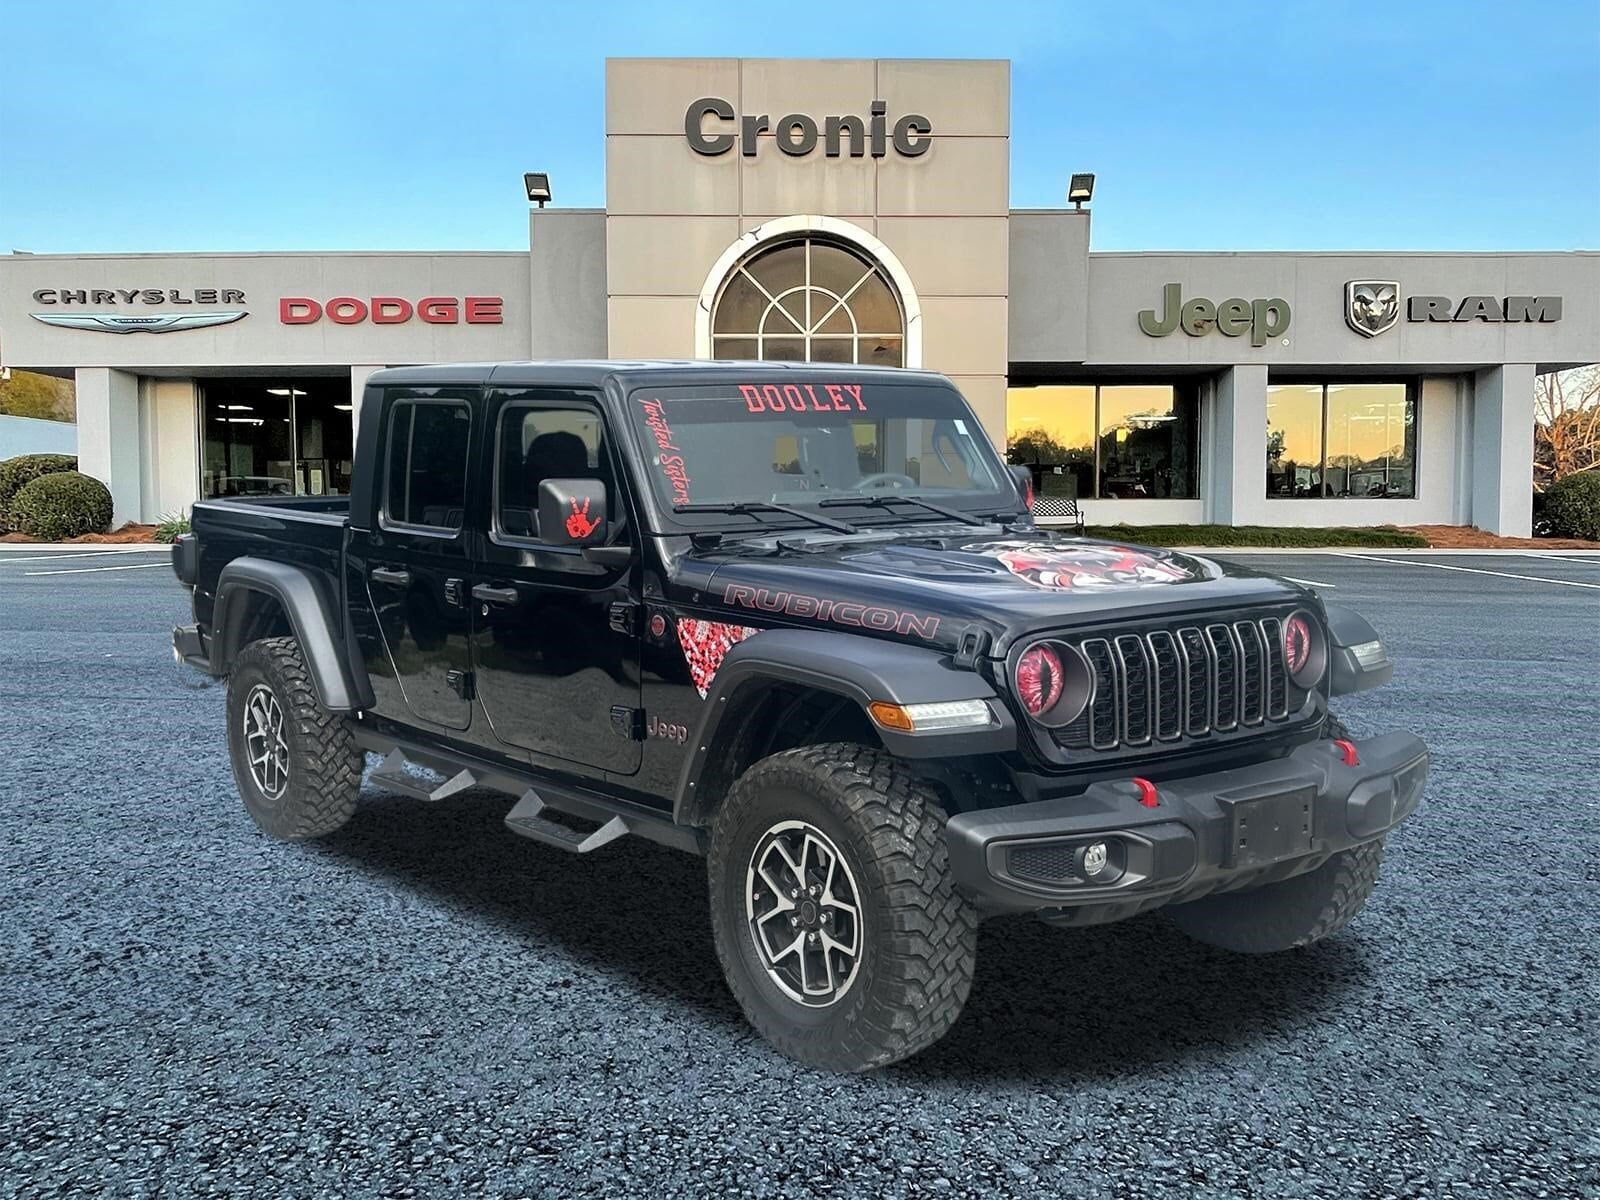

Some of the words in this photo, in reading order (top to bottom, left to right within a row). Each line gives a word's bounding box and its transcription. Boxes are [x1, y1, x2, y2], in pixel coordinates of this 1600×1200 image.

[684, 97, 932, 157] Cronic
[32, 288, 246, 305] CHRYSLER
[279, 296, 503, 325] DODGE
[1407, 296, 1562, 322] RAM
[1138, 283, 1291, 347] Jeep
[738, 384, 867, 412] DOOLEY
[638, 399, 680, 451] Twisted
[660, 453, 691, 505] Sisters
[723, 583, 941, 639] RUBICON
[647, 716, 688, 744] Jeep
